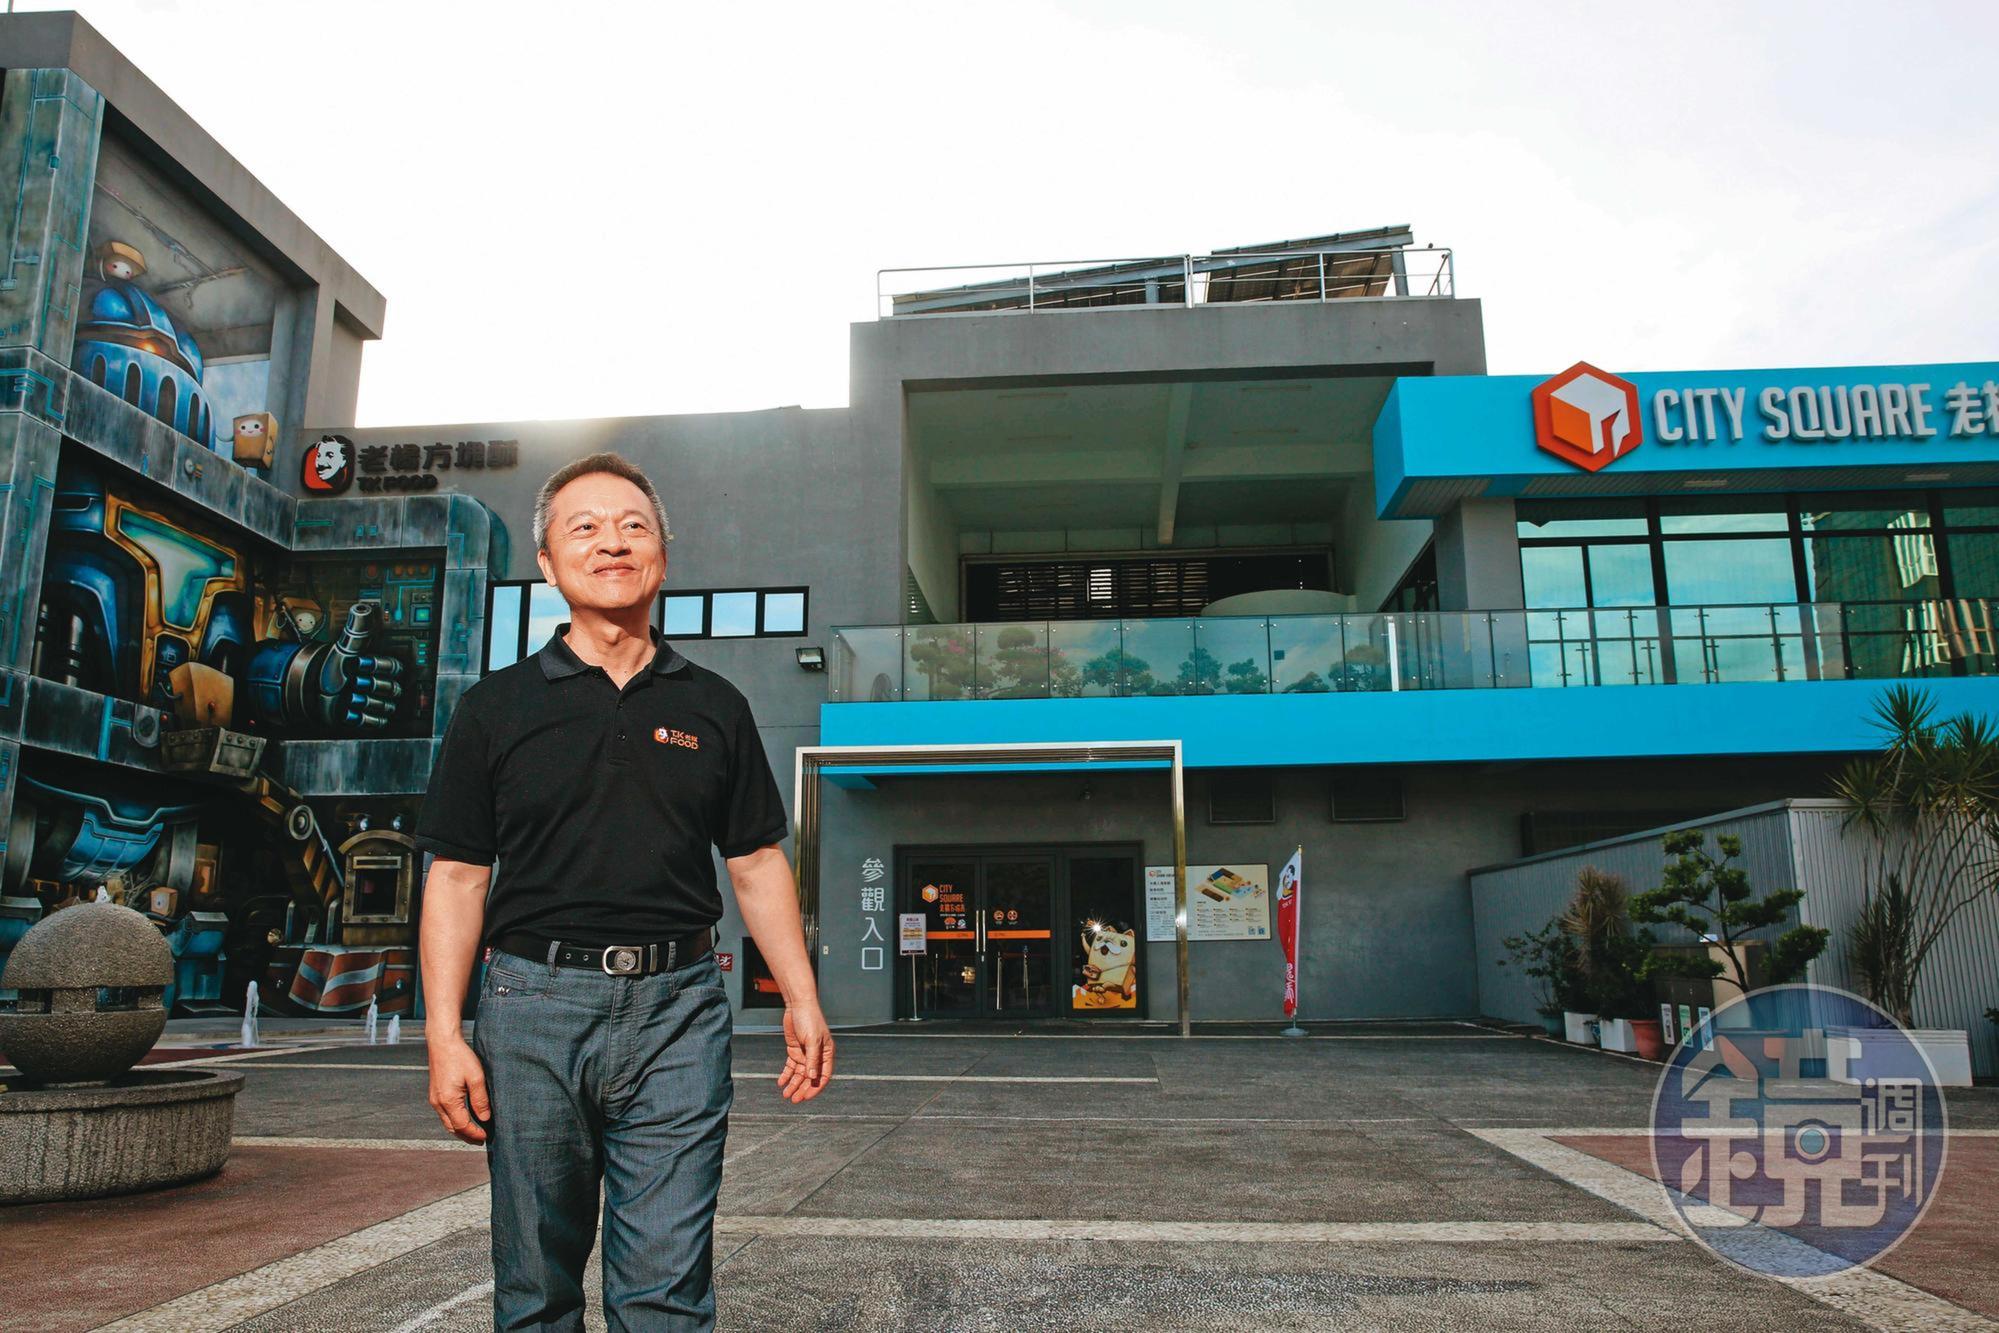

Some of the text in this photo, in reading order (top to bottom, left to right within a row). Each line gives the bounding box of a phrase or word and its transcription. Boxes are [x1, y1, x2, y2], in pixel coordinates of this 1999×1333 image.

[1653, 386, 1746, 442] CITY
[1759, 383, 1938, 440] SQUARE
[357, 440, 519, 473] 老楊方塊酥
[383, 474, 438, 491] FOOD
[670, 737, 699, 750] FOOD
[939, 884, 953, 893] CITY
[861, 857, 885, 970] 參觀入口
